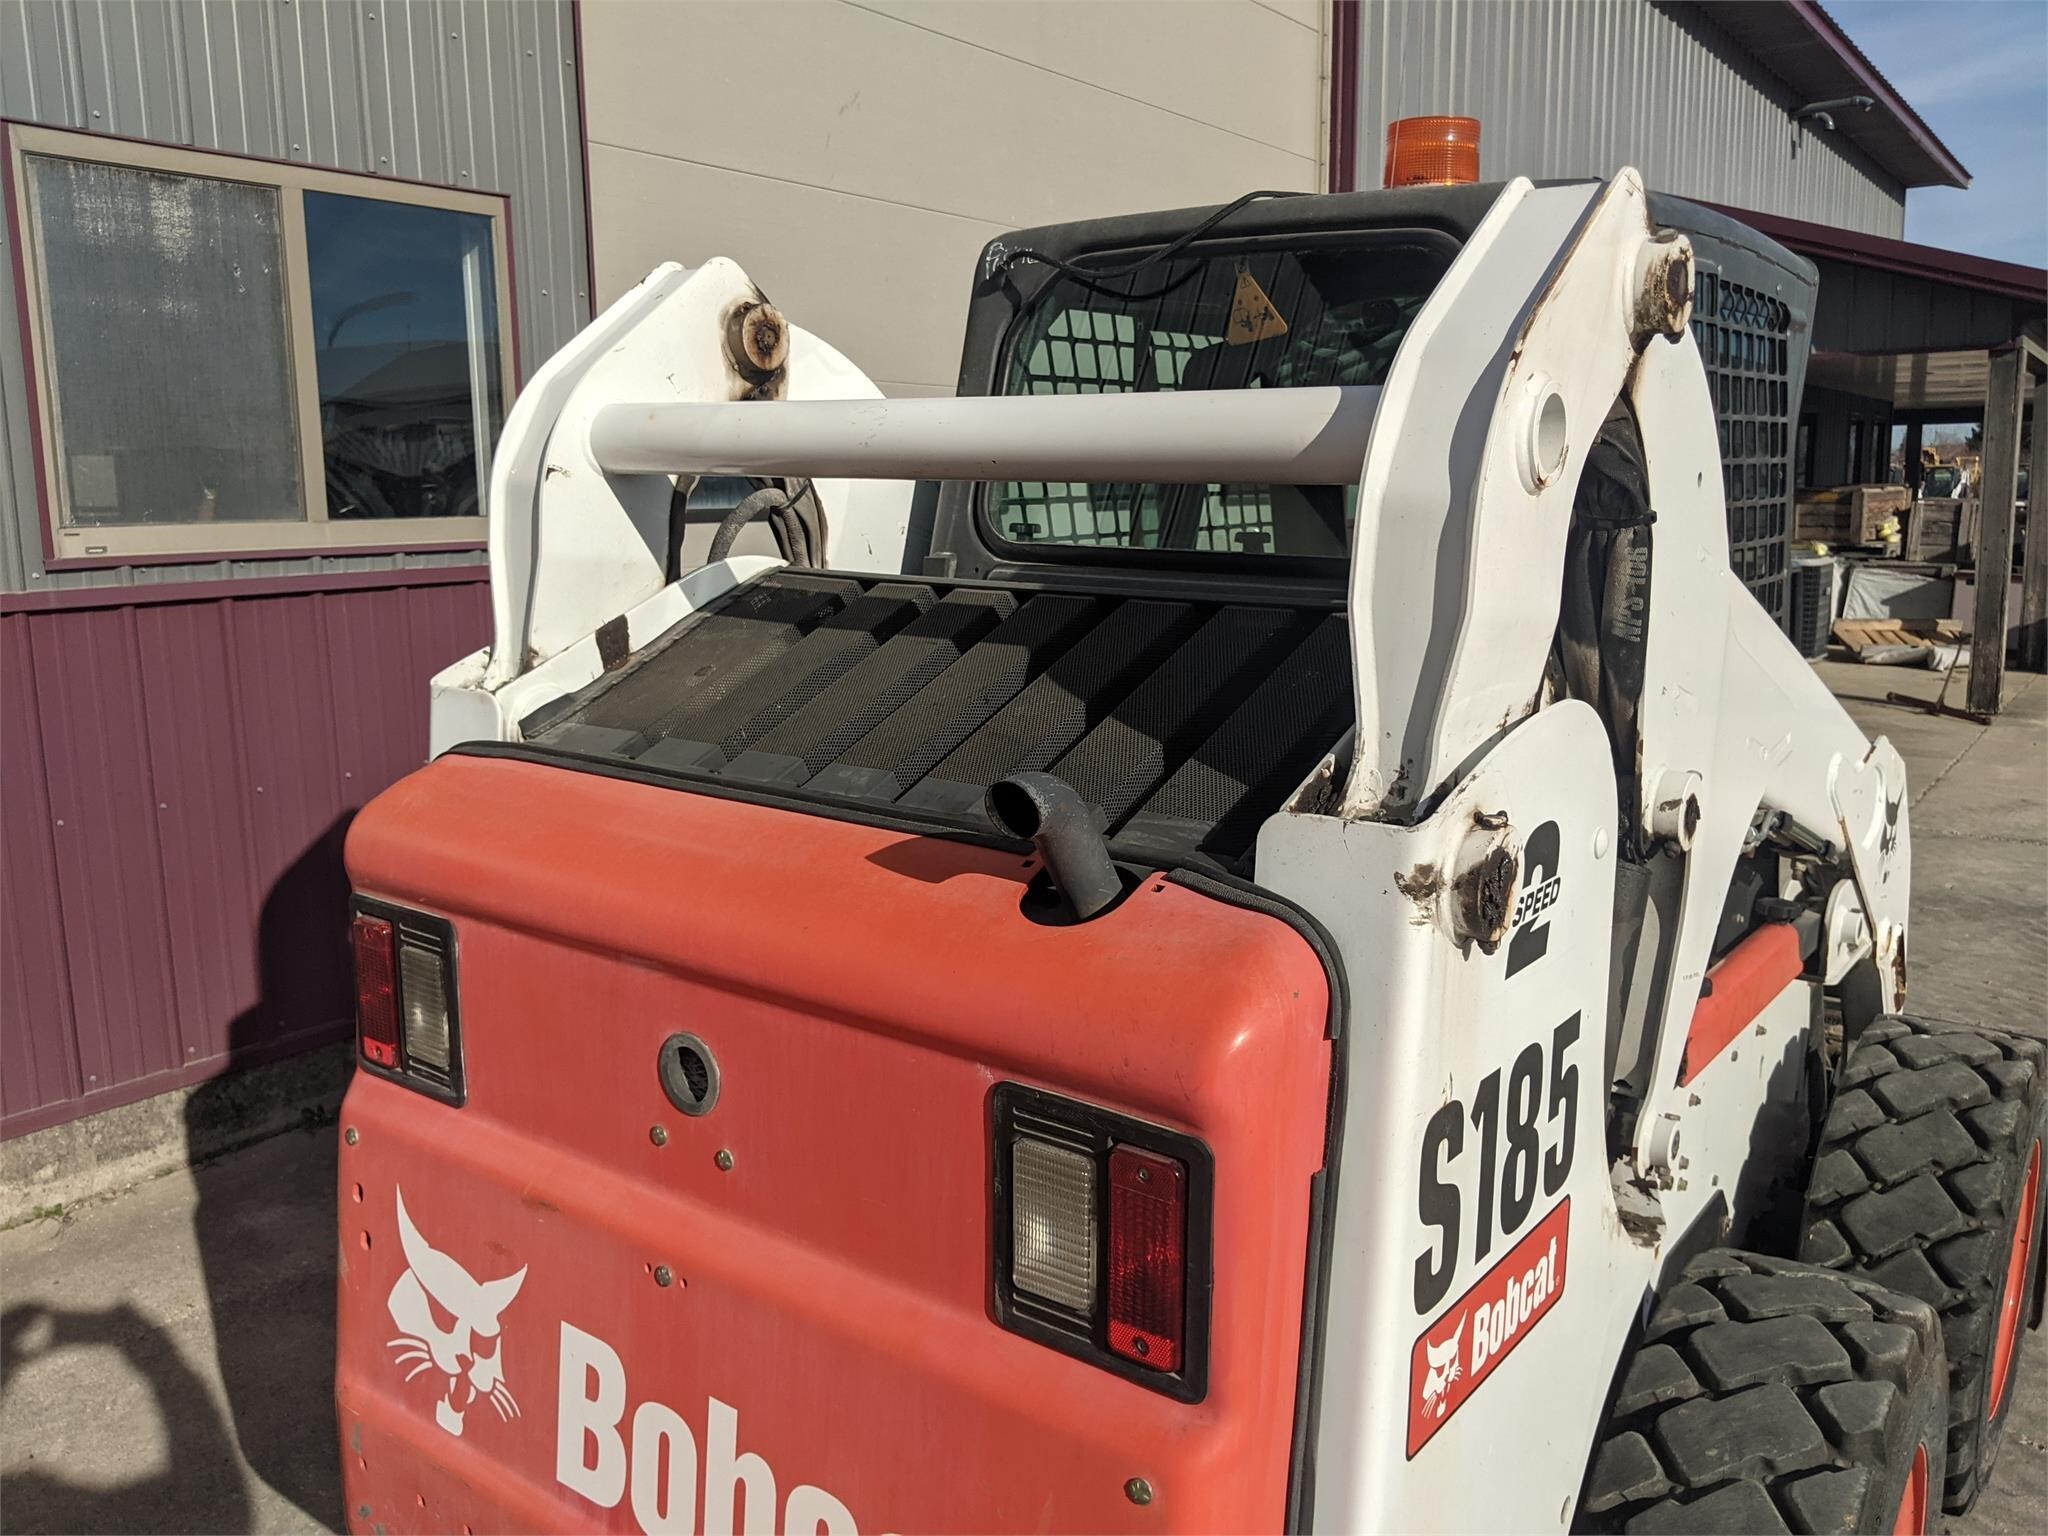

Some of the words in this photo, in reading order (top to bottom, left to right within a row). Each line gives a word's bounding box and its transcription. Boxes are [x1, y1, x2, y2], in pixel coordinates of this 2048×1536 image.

[1511, 876, 1561, 928] SPEED
[1413, 1008, 1582, 1316] S185
[1470, 1235, 1558, 1377] Bobcat
